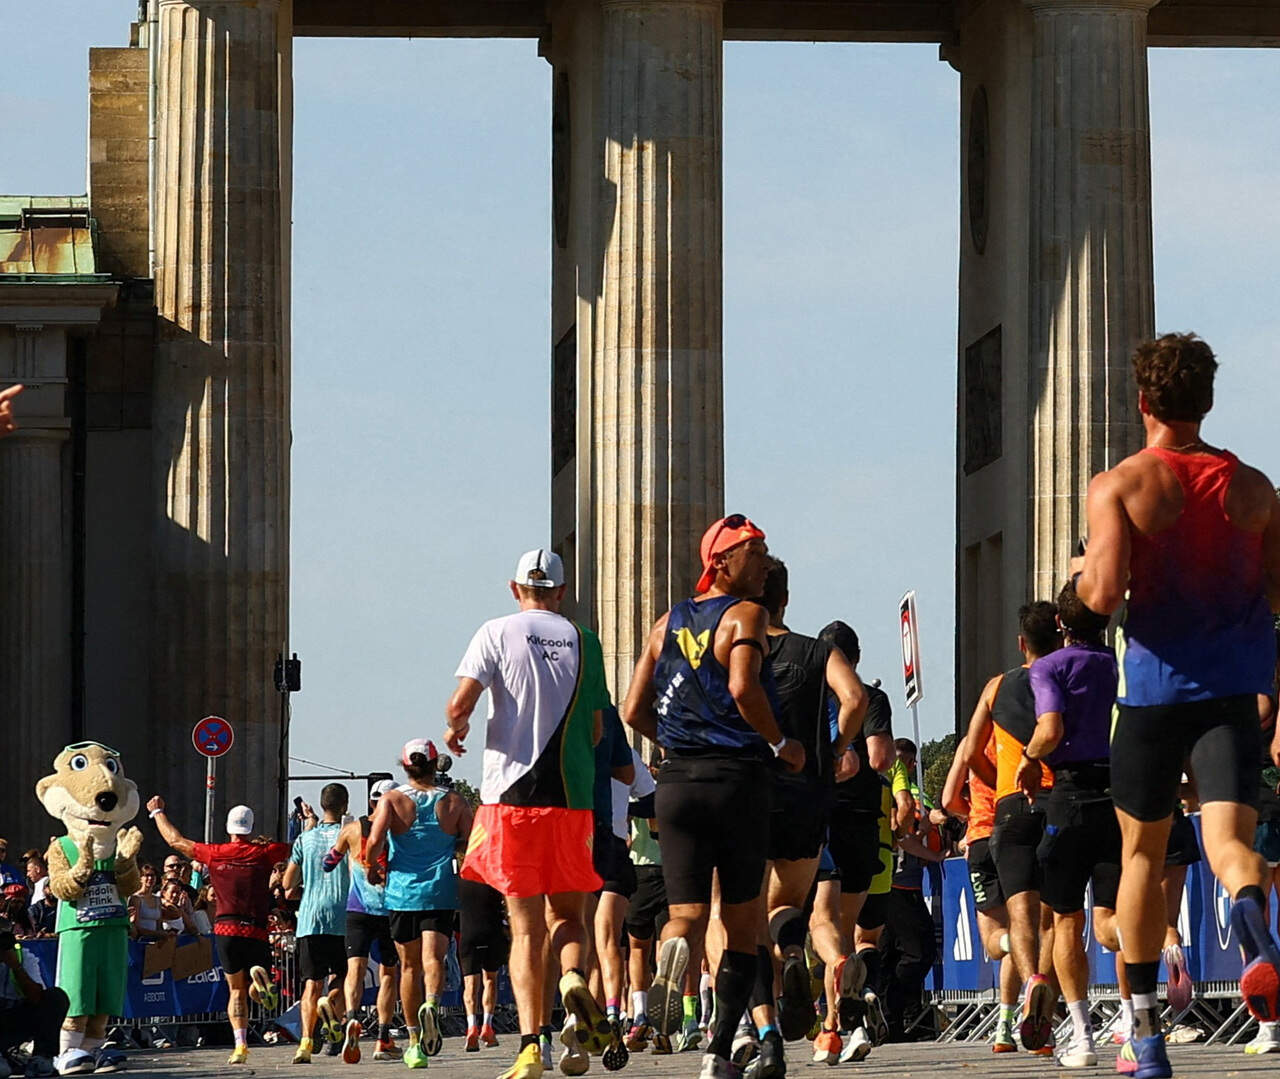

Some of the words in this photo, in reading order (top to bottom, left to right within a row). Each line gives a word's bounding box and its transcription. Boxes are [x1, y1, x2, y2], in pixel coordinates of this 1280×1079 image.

[526, 634, 573, 649] Kilcoole
[542, 651, 559, 662] AC
[90, 895, 113, 906] Flink
